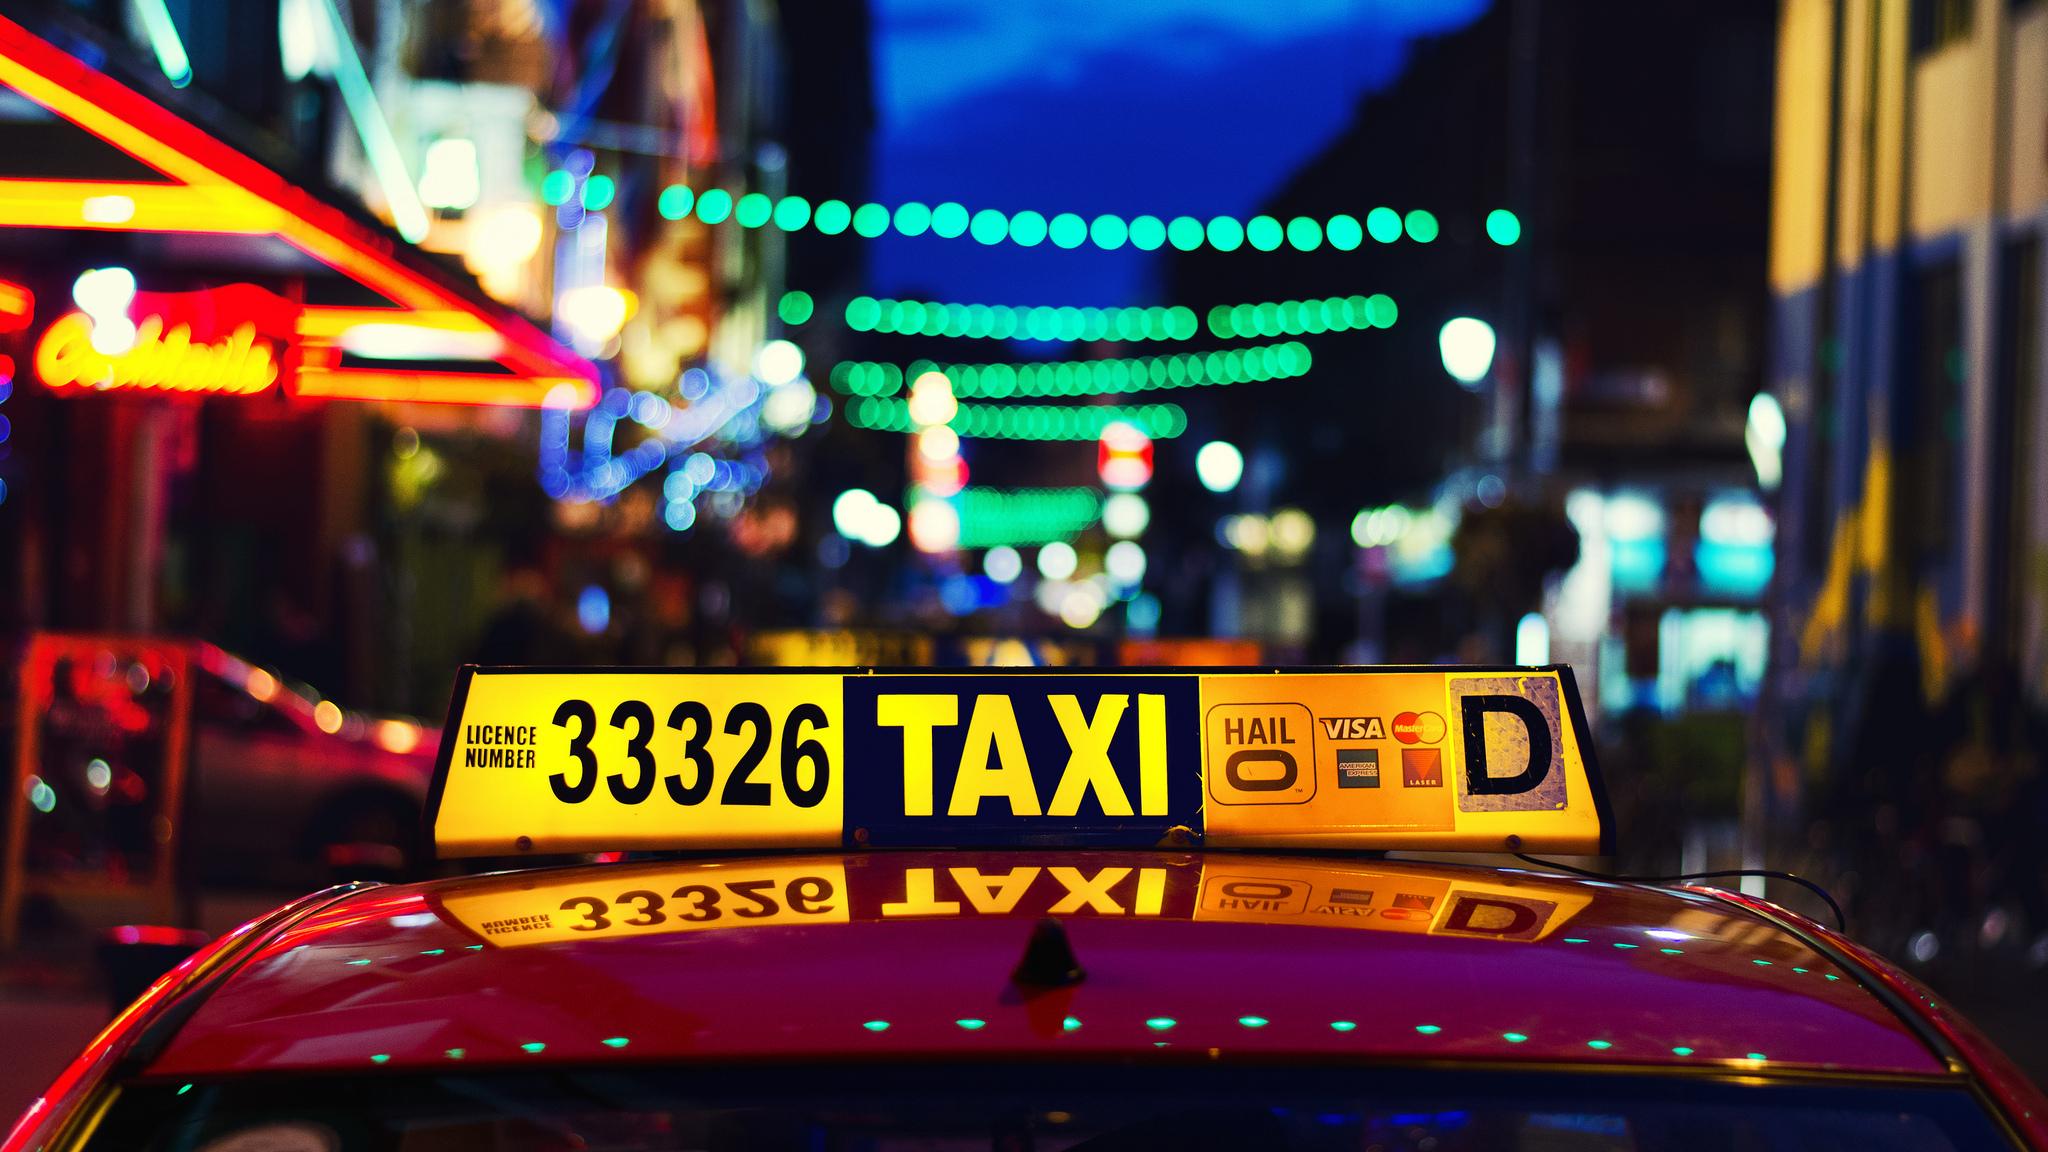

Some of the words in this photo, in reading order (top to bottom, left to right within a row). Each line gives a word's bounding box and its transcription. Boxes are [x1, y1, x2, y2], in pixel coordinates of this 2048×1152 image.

[467, 725, 537, 746] LICENCE
[1225, 717, 1295, 744] HAIL
[1325, 718, 1383, 738] VISA
[1395, 724, 1442, 733] MasterCard
[549, 699, 830, 808] 33326
[877, 693, 1168, 816] TAXI
[1461, 695, 1552, 796] D
[466, 748, 535, 769] NUMBER
[1339, 762, 1375, 770] AMERICAN
[1347, 769, 1378, 777] EXPRESS
